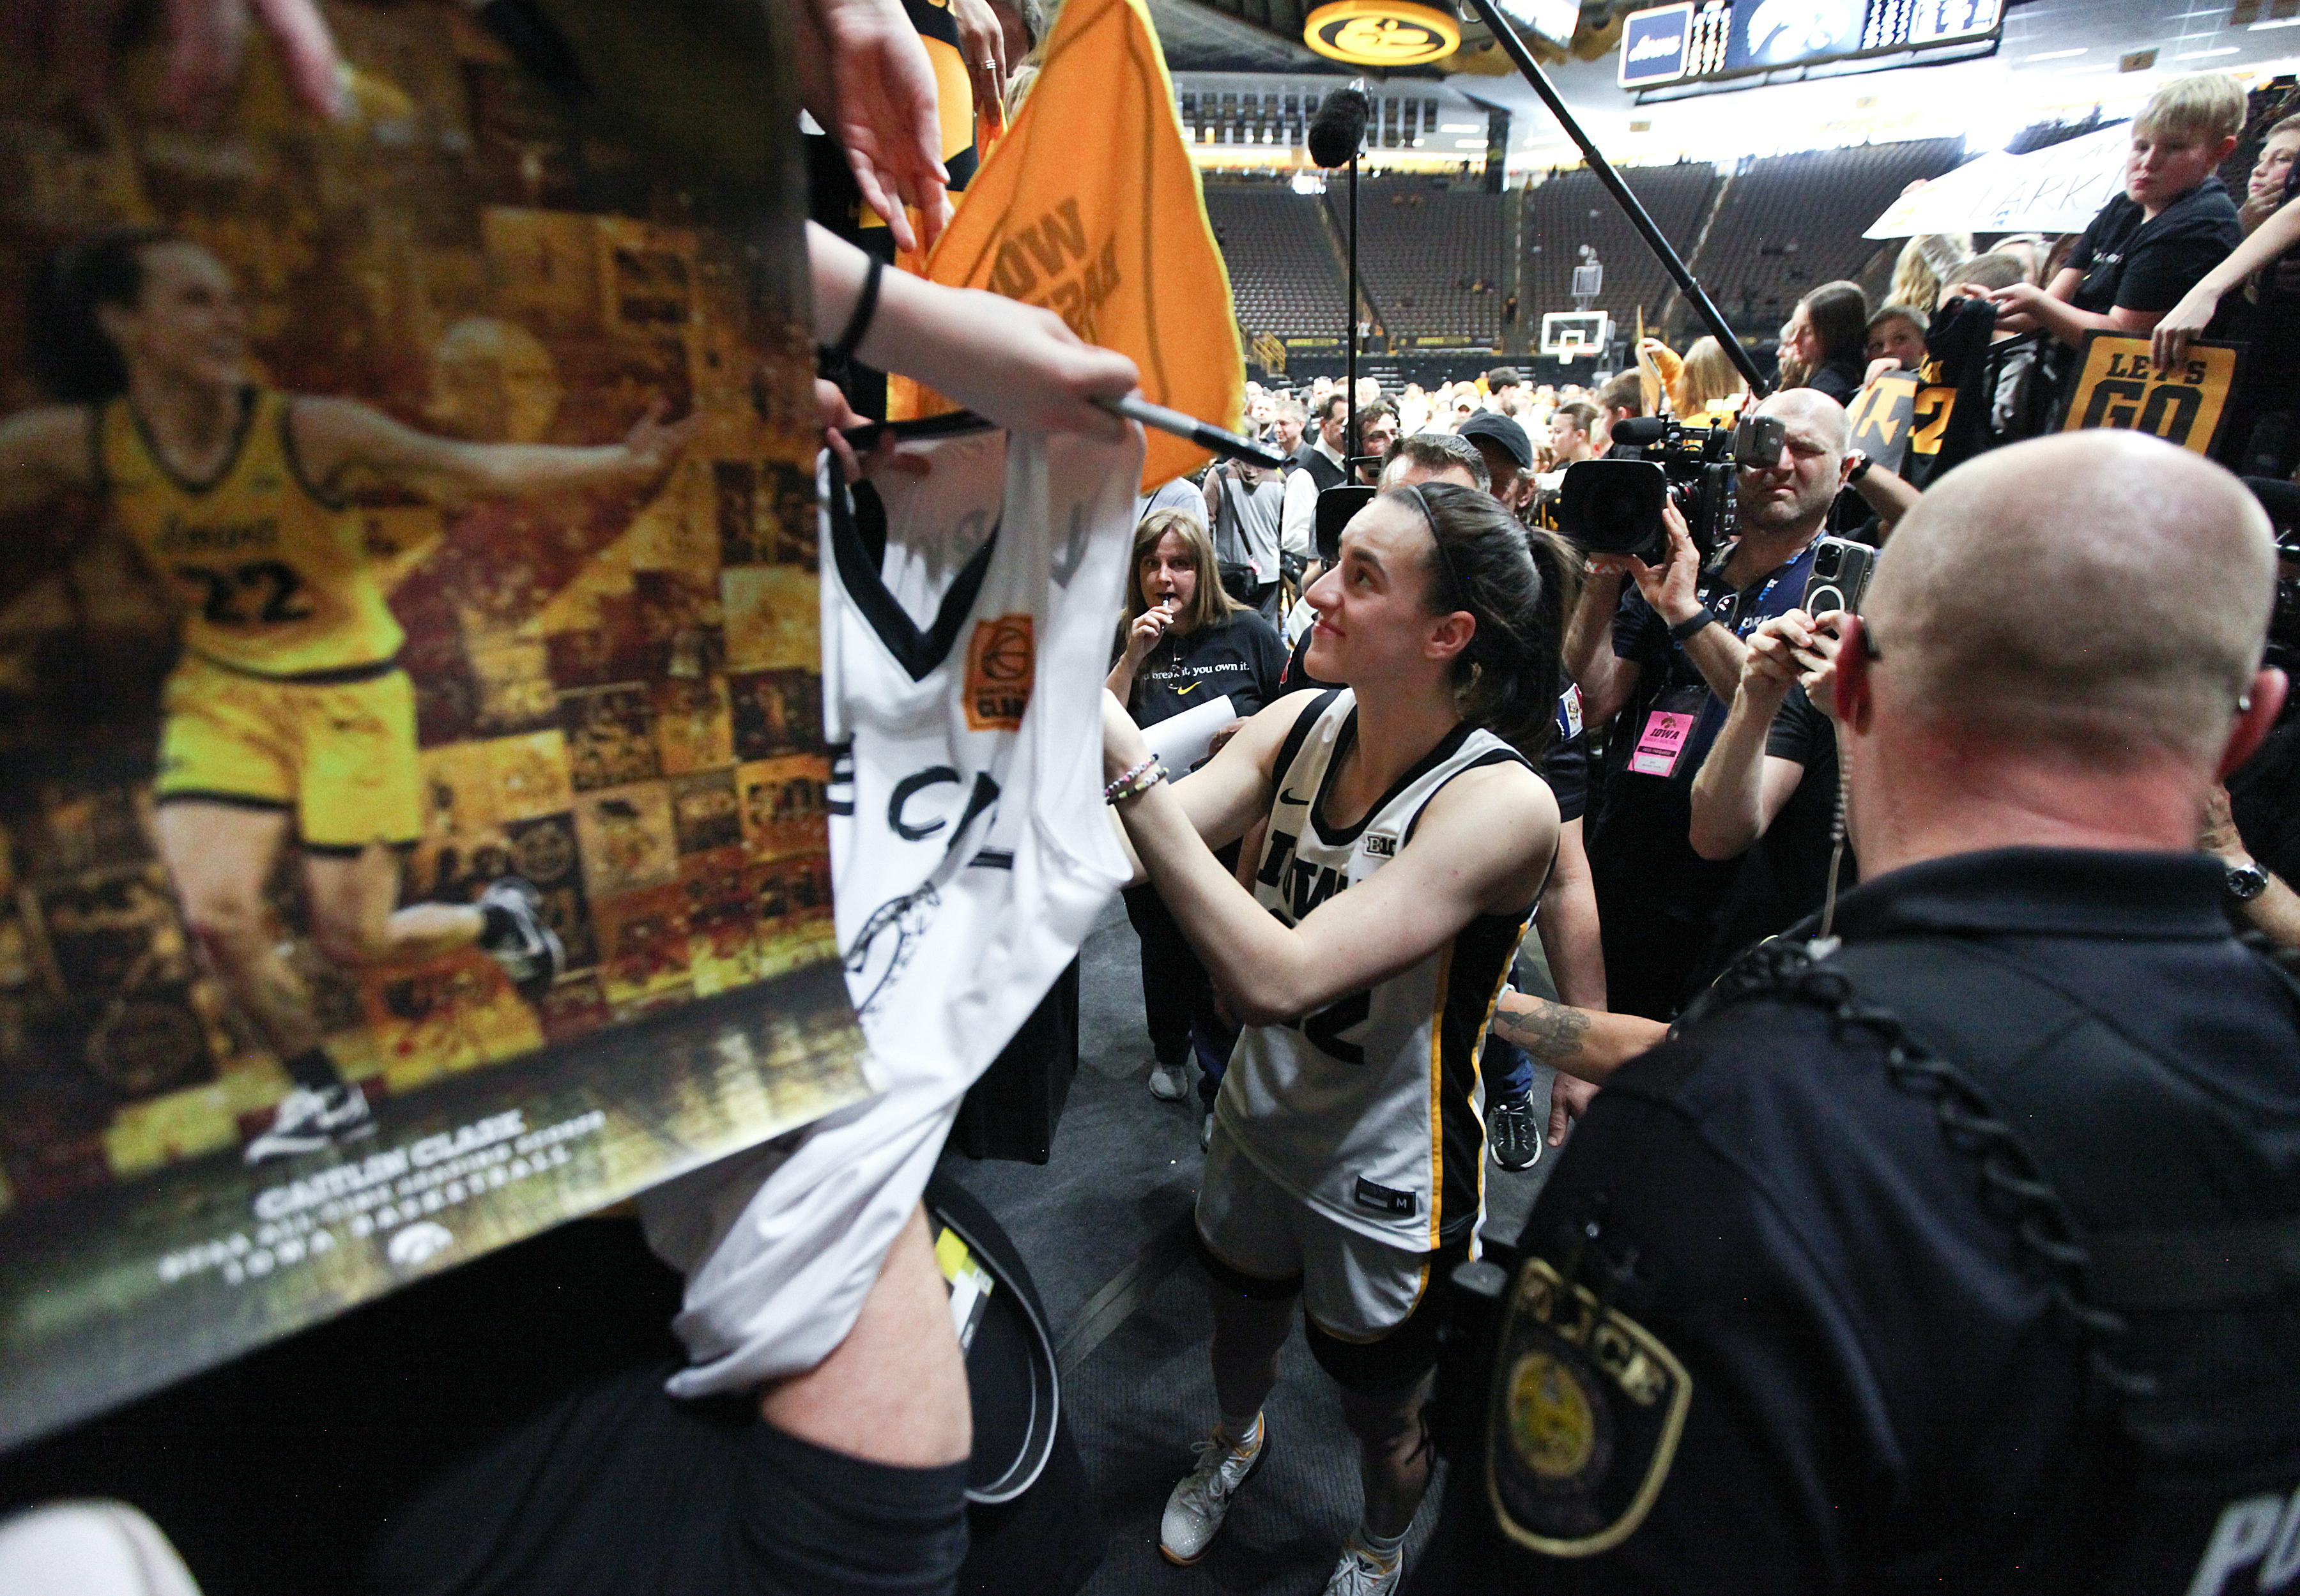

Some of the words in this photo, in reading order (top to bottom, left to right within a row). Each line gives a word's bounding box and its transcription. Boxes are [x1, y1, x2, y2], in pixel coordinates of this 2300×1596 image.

[2106, 353, 2206, 384] LES
[1193, 666, 1213, 677] you
[1215, 663, 1238, 671] own
[1240, 661, 1250, 671] it.
[1650, 728, 1680, 740] IOWA
[1396, 1197, 1407, 1209] M
